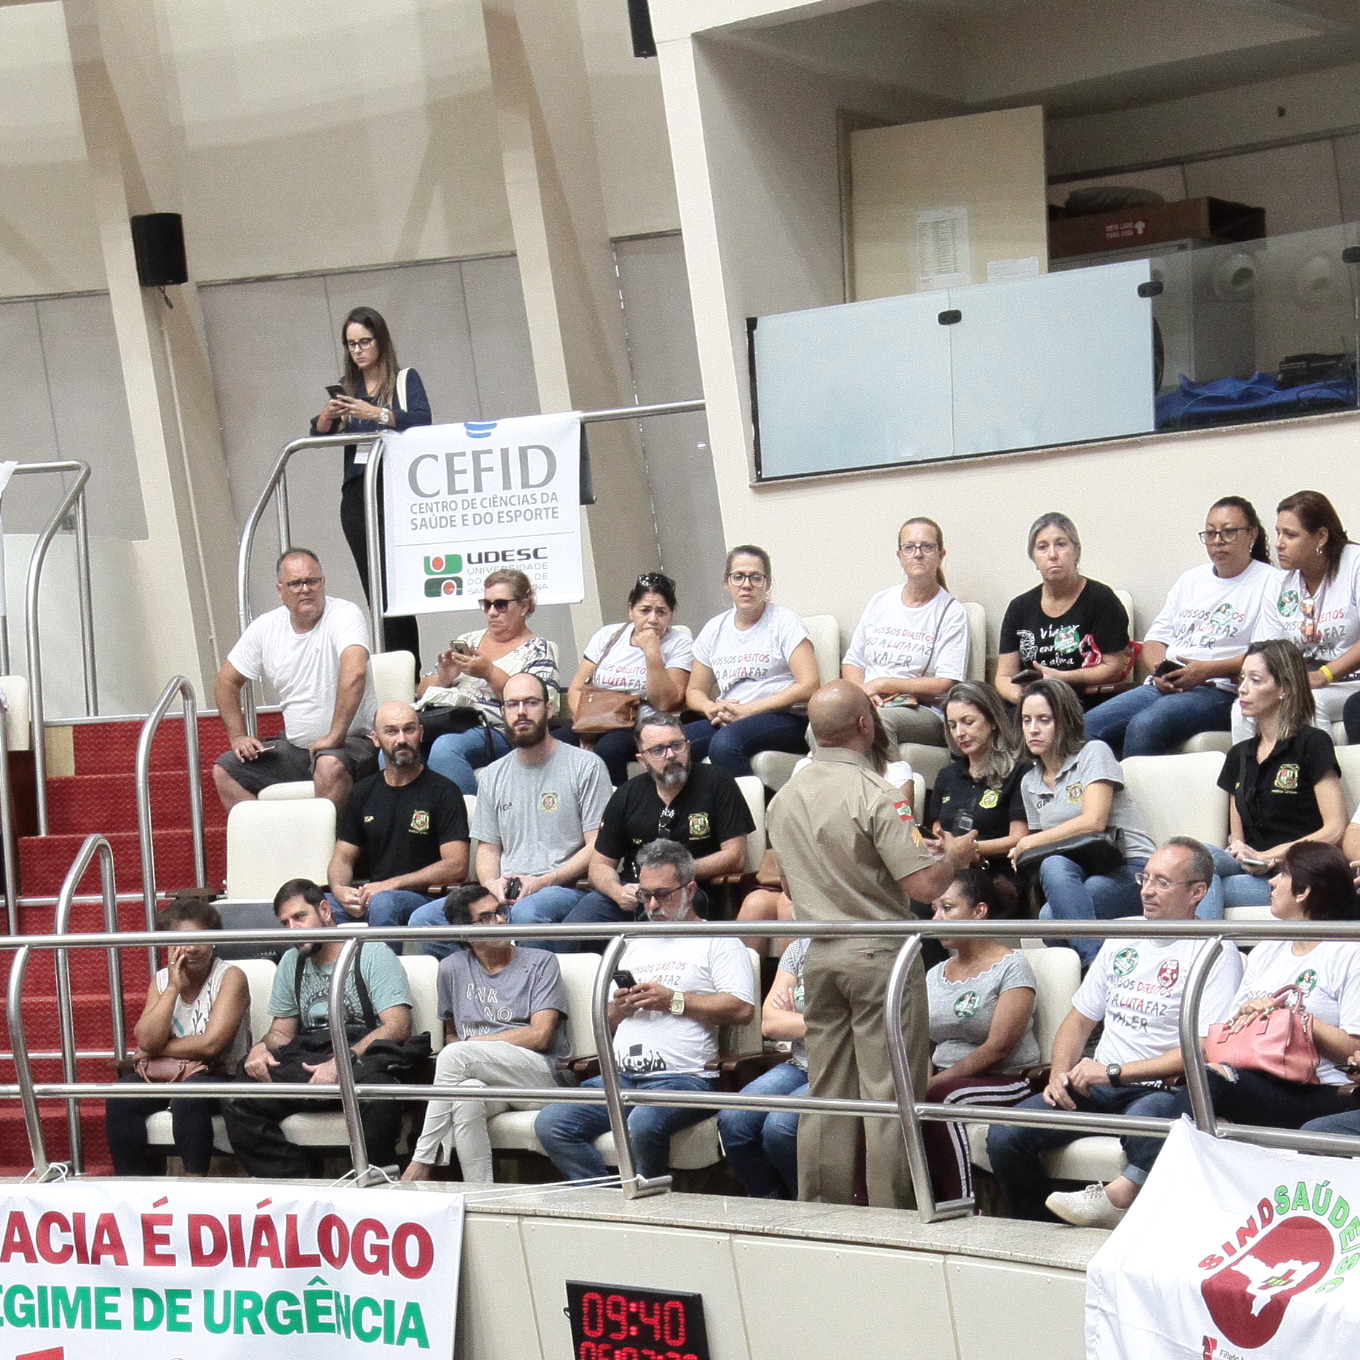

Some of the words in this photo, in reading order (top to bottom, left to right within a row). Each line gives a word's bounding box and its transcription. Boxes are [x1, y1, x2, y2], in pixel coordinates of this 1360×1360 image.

[407, 444, 557, 498] CEFID
[410, 500, 457, 515] CENTRO
[461, 499, 478, 510] DE
[480, 493, 537, 510] CIÊNCIAS
[541, 491, 559, 504] DA
[410, 512, 457, 531] SAÚDE
[461, 515, 469, 527] E
[473, 513, 494, 526] DO
[497, 506, 560, 524] ESPORTE
[467, 547, 548, 564] UDESC
[1216, 625, 1238, 638] FAZ
[1323, 624, 1346, 641] FAZ
[888, 640, 912, 650] LUTA
[912, 643, 933, 656] FAZ
[873, 651, 912, 668] VALER
[616, 665, 647, 675] DIREITO
[749, 668, 769, 677] FAZ
[602, 675, 627, 685] LUTA
[483, 1005, 513, 1022] NO
[1120, 996, 1144, 1013] LUTA
[1145, 1000, 1169, 1017] FAZ
[141, 1196, 176, 1266] É
[187, 1196, 435, 1280] DIÁLOGO
[132, 1287, 194, 1335] DE
[203, 1275, 430, 1350] URGÊNCIA
[582, 1291, 686, 1347] 09:40
